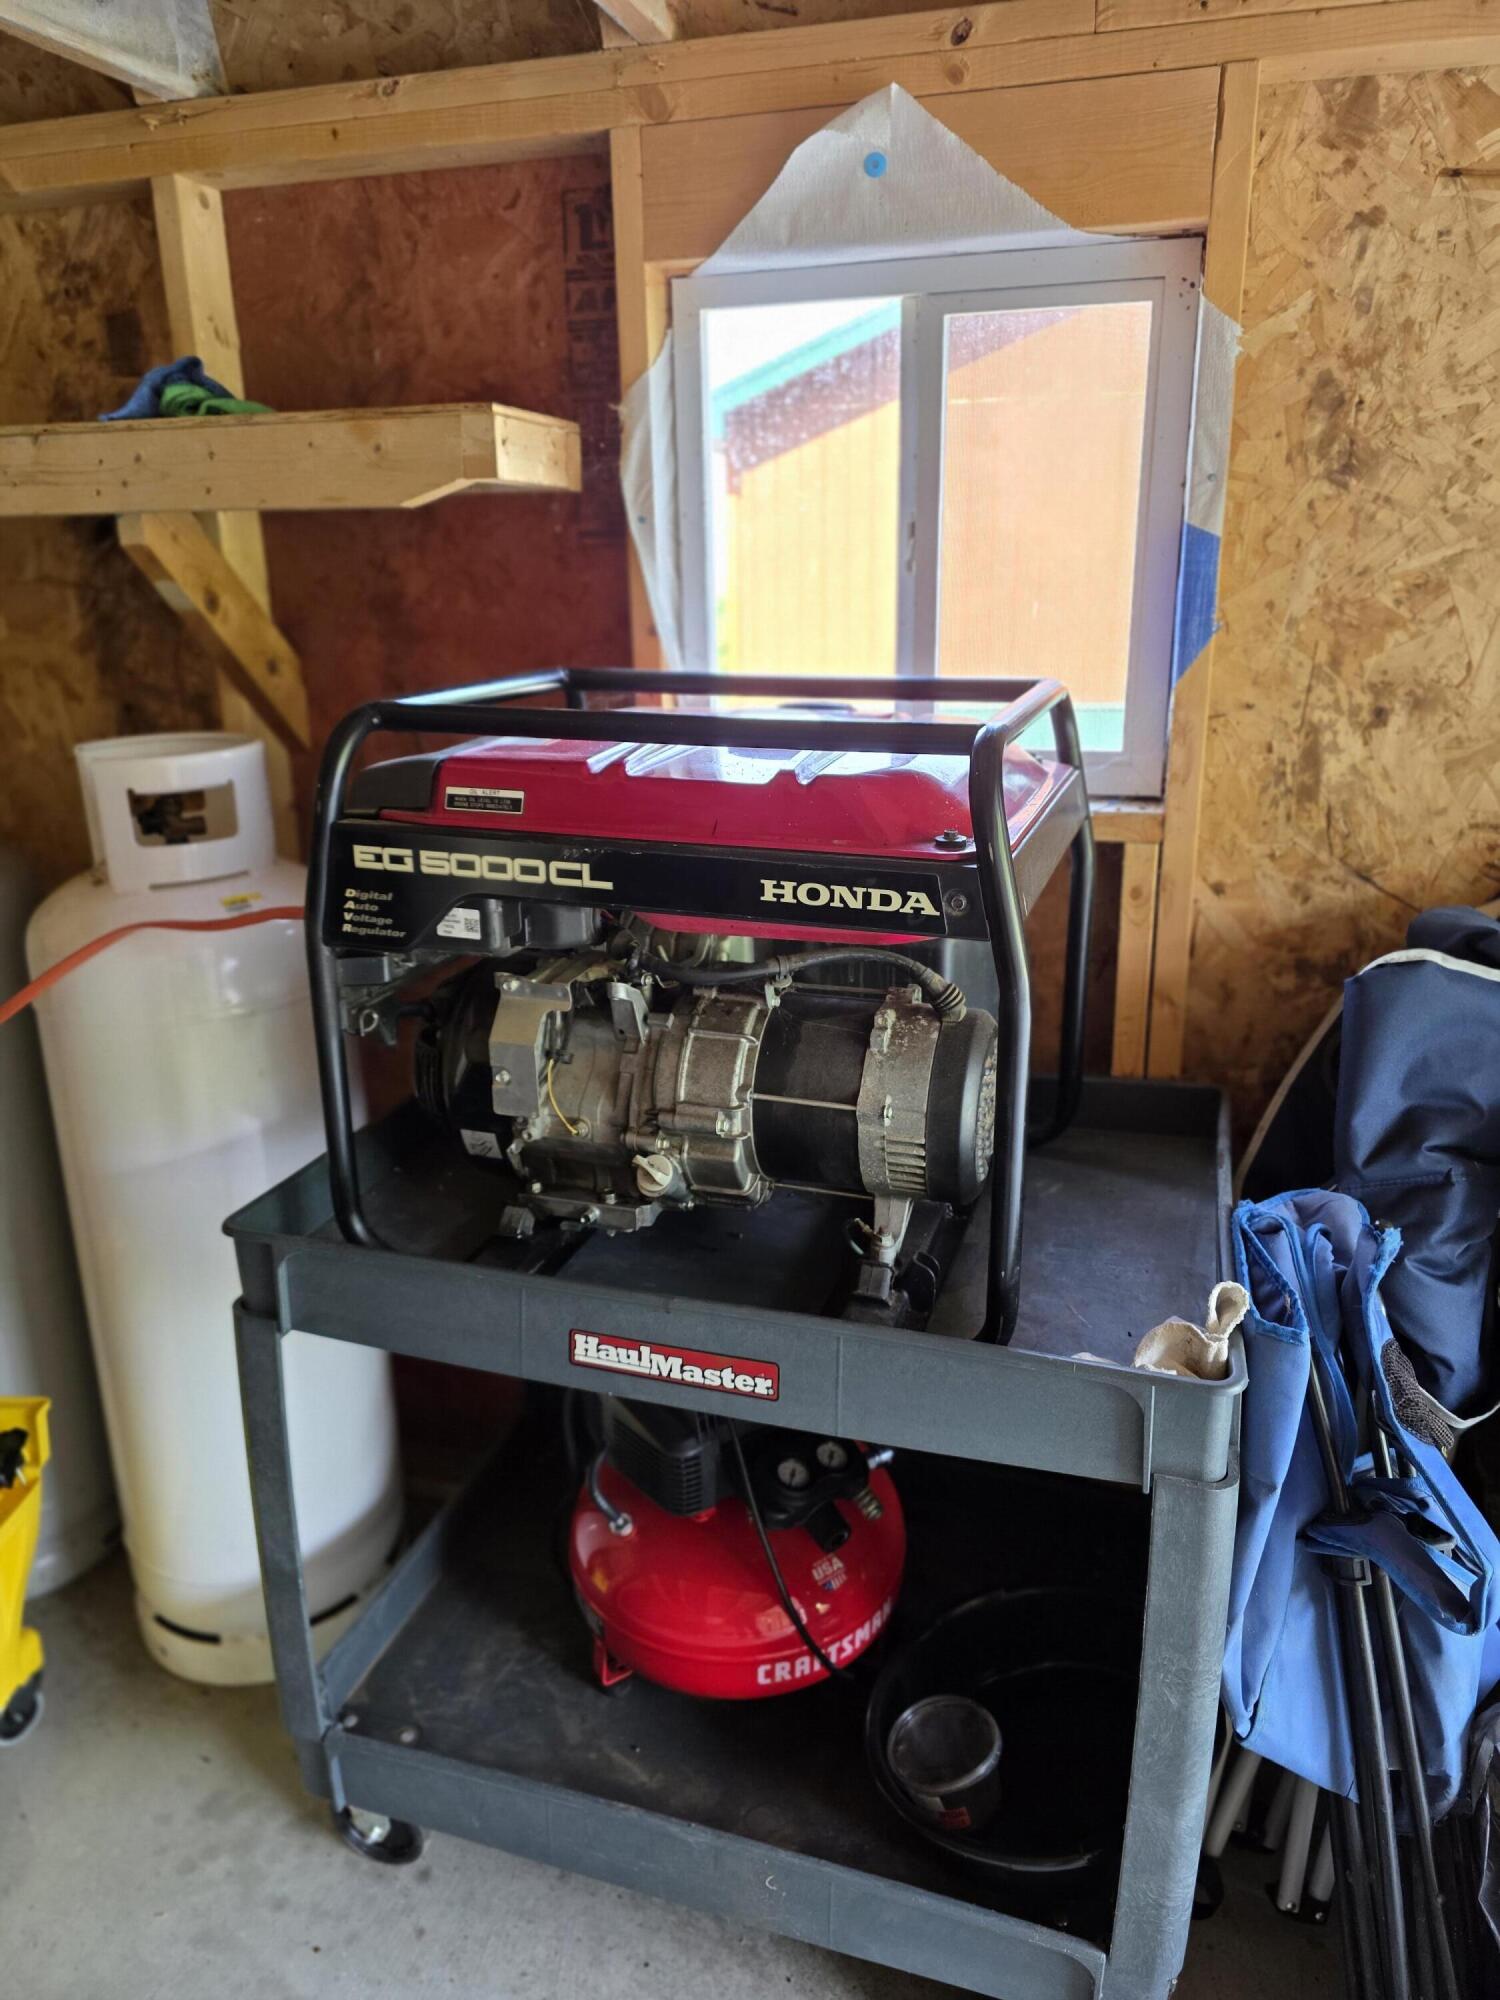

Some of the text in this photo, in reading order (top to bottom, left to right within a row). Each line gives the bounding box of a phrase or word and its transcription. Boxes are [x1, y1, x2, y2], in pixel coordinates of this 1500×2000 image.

[344, 888, 393, 901] Digital
[760, 879, 941, 916] HONDA
[344, 900, 379, 912] Auto
[343, 912, 393, 925] Voltage
[342, 923, 407, 937] Regulator
[812, 1557, 844, 1580] USA
